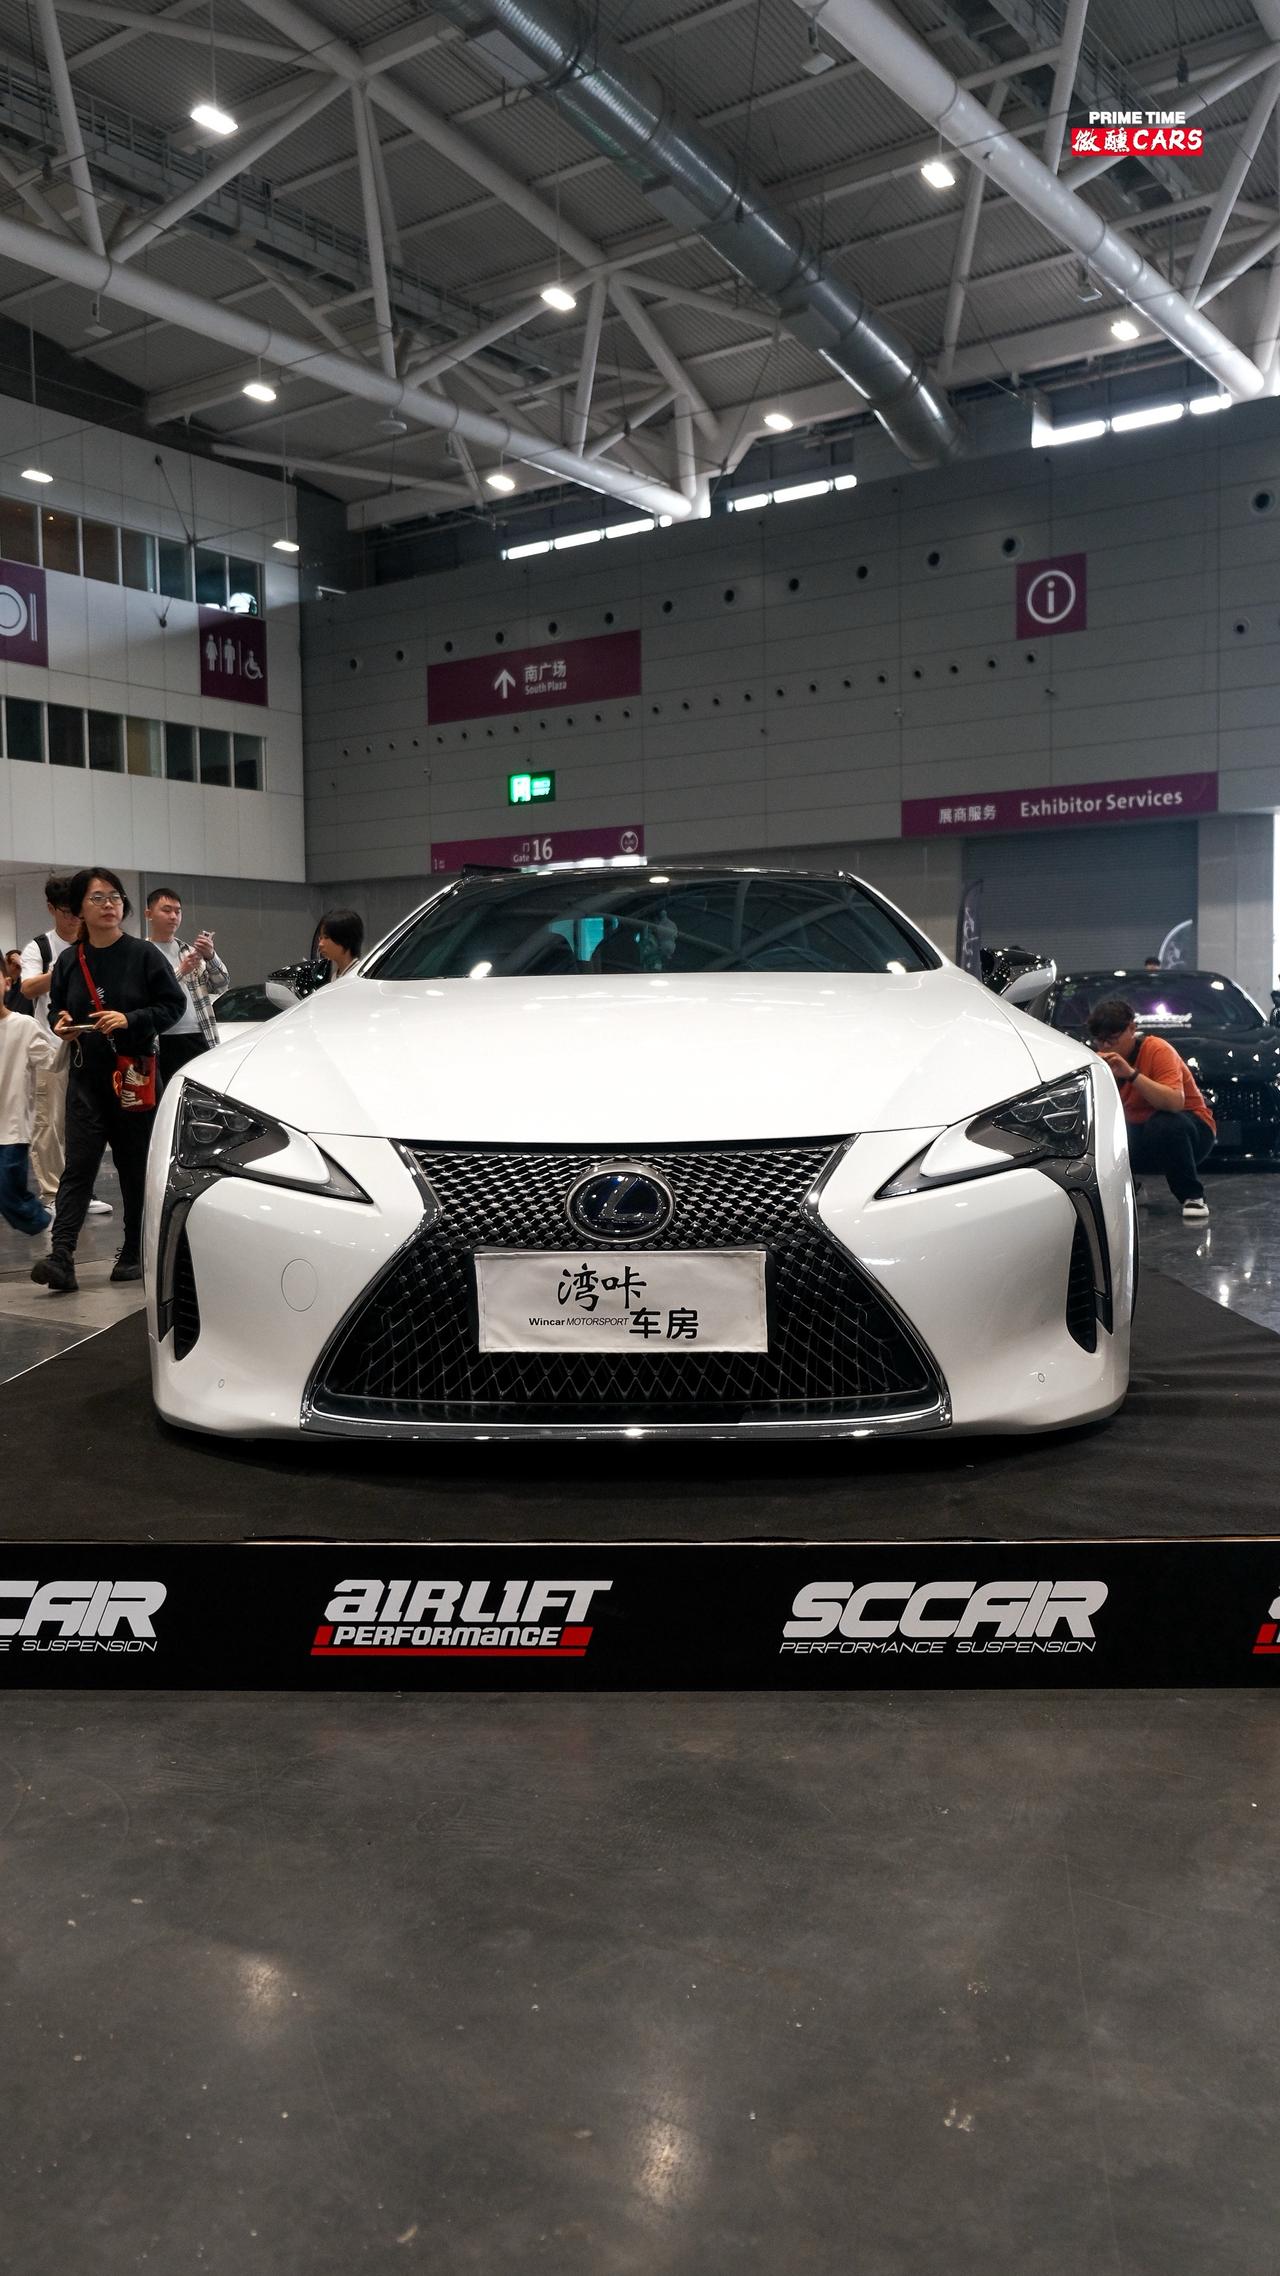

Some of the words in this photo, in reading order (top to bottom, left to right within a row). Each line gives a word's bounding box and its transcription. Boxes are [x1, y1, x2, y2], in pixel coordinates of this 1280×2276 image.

[524, 660, 567, 683] 南广场
[525, 682, 547, 695] South
[548, 680, 567, 691] Plaza
[1020, 796, 1103, 817] Exhibitor
[1106, 790, 1183, 811] Services
[939, 805, 996, 823] 展商服务
[513, 853, 530, 863] Gate
[533, 838, 553, 861] 16
[557, 1262, 647, 1312] 湾咔
[529, 1317, 565, 1326] Wincar
[566, 1317, 629, 1326] MOTORSPORT
[629, 1307, 699, 1339] 车房
[782, 1580, 1109, 1638] SCCAIR
[22, 1639, 158, 1652] SUSPENSION
[779, 1641, 944, 1654] PERFORMANCE
[956, 1640, 1097, 1653] SUSPENSION
